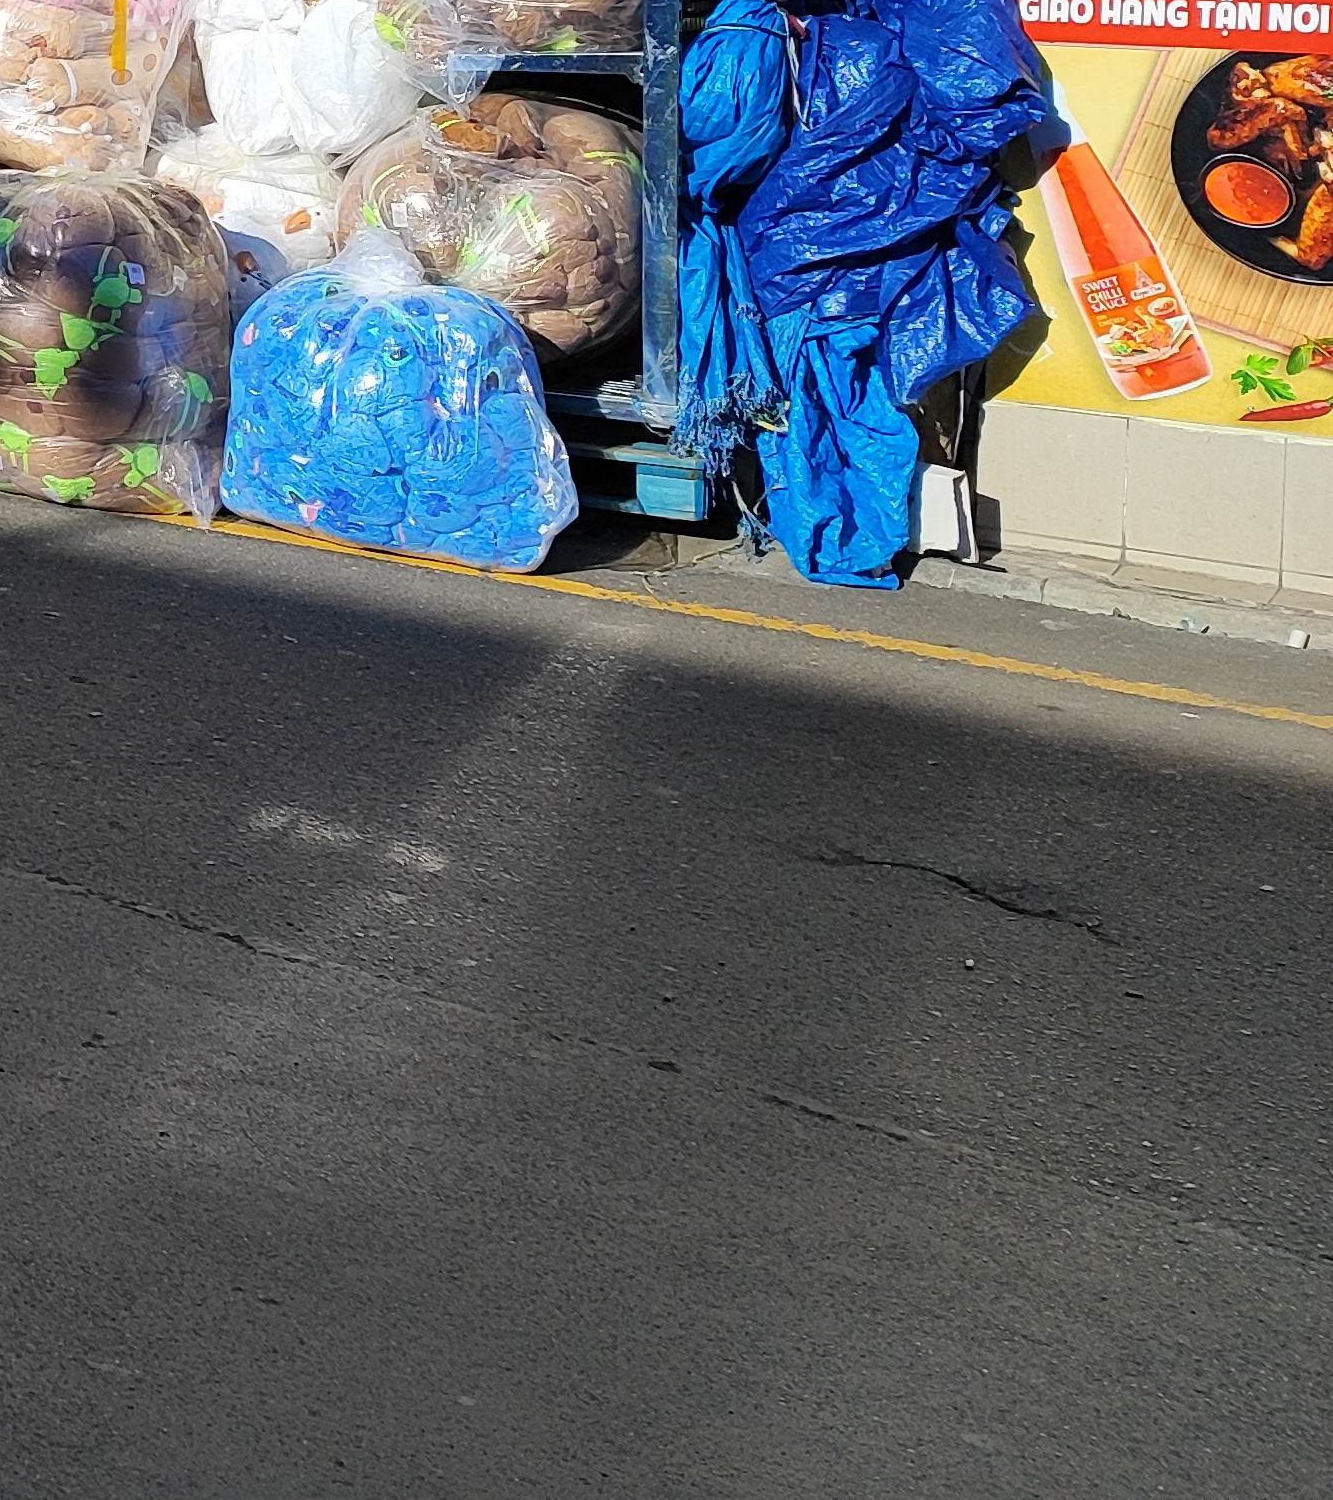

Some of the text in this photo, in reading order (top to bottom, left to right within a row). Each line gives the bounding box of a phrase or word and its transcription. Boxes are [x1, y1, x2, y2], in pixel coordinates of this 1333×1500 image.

[1268, 3, 1331, 34] NƠI
[1082, 275, 1119, 293] SWEET
[1087, 287, 1124, 304] CHILLI
[1091, 297, 1129, 313] SAUCE
